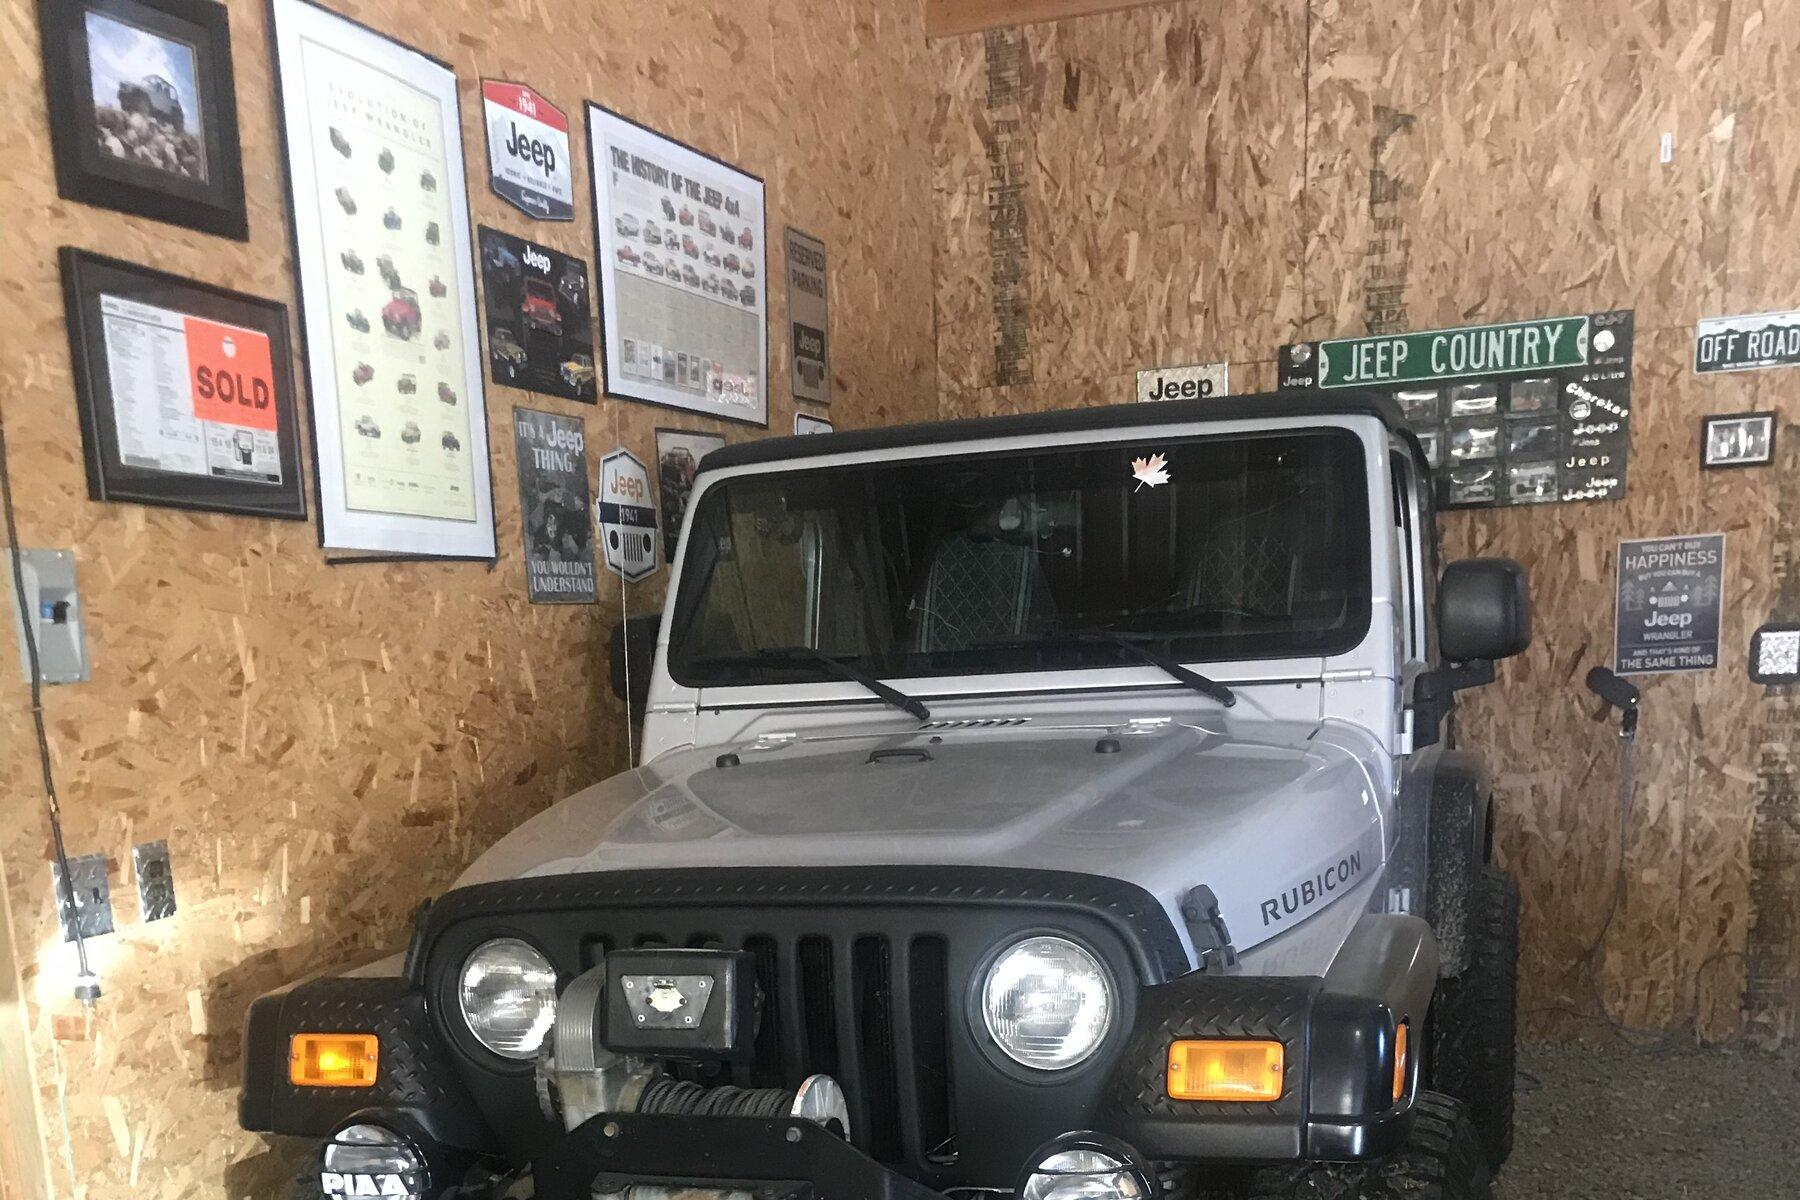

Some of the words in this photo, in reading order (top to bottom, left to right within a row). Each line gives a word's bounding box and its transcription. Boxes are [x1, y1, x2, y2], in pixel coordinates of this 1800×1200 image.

[506, 121, 556, 178] Jeep
[610, 145, 630, 173] THE
[630, 153, 670, 190] HISTORY
[671, 171, 683, 195] OF
[684, 177, 702, 202] THE
[703, 185, 723, 211] JEEP
[523, 245, 551, 275] Jeep
[789, 242, 824, 272] RESERVED
[791, 268, 823, 299] PARKING
[800, 329, 821, 354] Jeep
[1342, 339, 1409, 381] JEEP
[1430, 324, 1565, 374] COUNTRY
[1700, 334, 1740, 363] OFF
[1747, 328, 1800, 359] ROAD
[196, 365, 270, 411] SOLD
[1148, 377, 1214, 400] Jeep
[1283, 375, 1313, 388] Jeep
[1566, 382, 1629, 418] Cherokee
[519, 421, 536, 440] IT'S
[546, 421, 584, 457] Jeep
[1572, 422, 1619, 436] Jeep
[1565, 455, 1611, 468] Jeep
[610, 468, 644, 503] Jeep
[1586, 477, 1619, 488] Jeep
[1562, 488, 1609, 501] Jeep
[621, 507, 639, 523] 1941
[1641, 543, 1659, 553] YOU
[1660, 541, 1682, 552] CAN'T
[1684, 540, 1701, 550] BUY
[531, 560, 550, 576] YOU
[551, 560, 593, 577] WOULDN'T
[1625, 550, 1718, 571] HAPPINESS
[533, 576, 595, 594] UNDERSTAND
[1643, 610, 1693, 629] Jeep
[1643, 630, 1694, 641] WRANGLER
[1621, 658, 1643, 669] THE
[1645, 656, 1677, 668] SAME
[1679, 654, 1715, 666] THING
[1632, 647, 1648, 657] AND
[1649, 646, 1673, 656] THAT'S
[1673, 646, 1691, 654] KIND
[1260, 850, 1361, 926] RUBICON
[321, 1172, 410, 1195] PIAA
